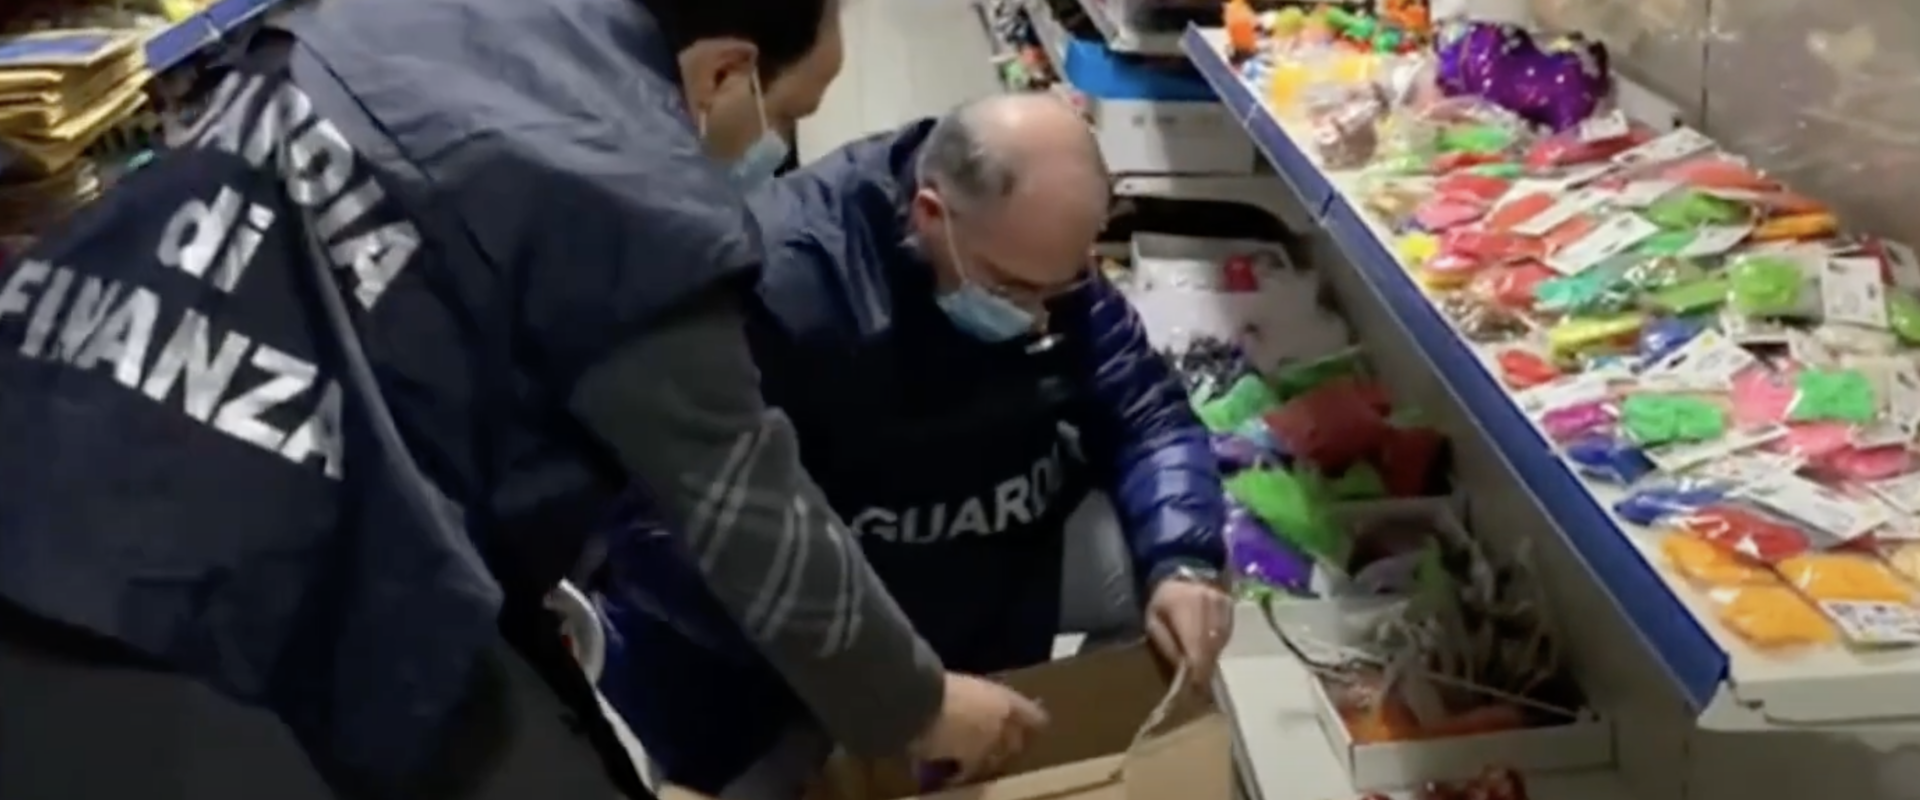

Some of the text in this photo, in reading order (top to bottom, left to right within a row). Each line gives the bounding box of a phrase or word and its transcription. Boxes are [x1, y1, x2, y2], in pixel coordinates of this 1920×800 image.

[157, 186, 276, 293] di
[163, 72, 421, 312] UARDIA
[0, 259, 343, 480] FINANZA
